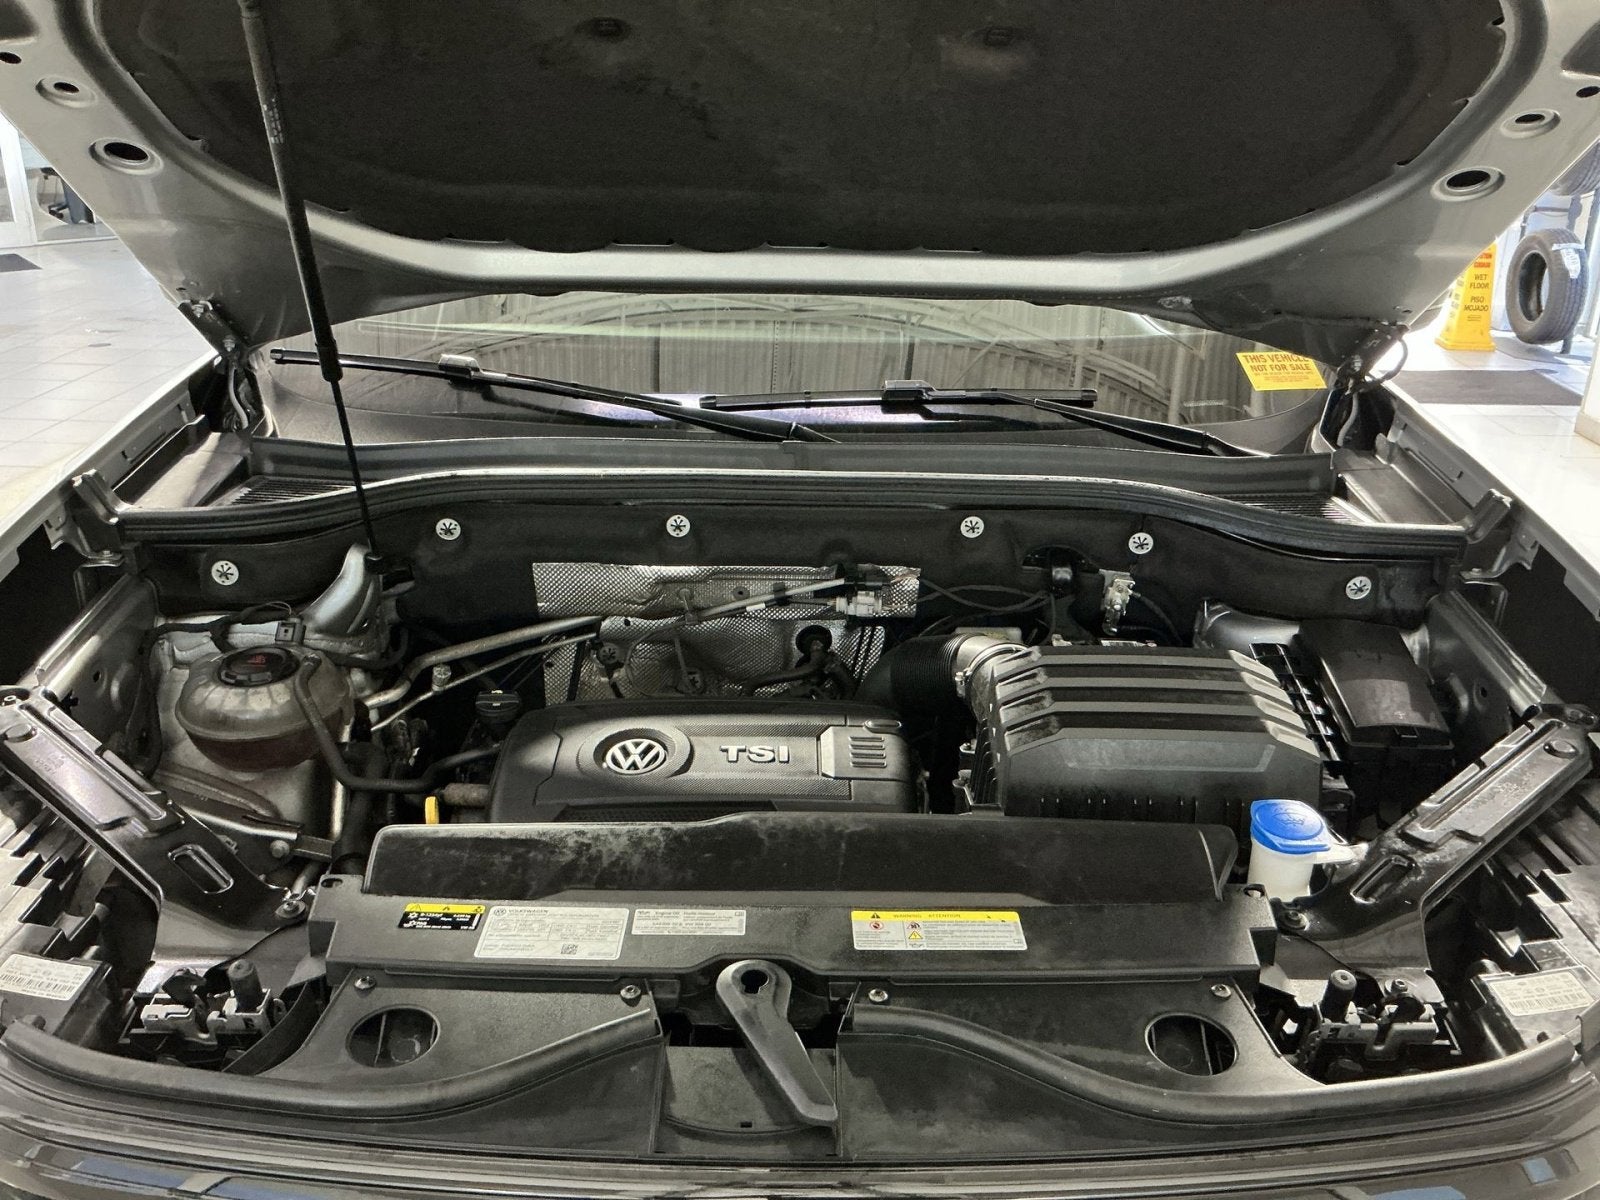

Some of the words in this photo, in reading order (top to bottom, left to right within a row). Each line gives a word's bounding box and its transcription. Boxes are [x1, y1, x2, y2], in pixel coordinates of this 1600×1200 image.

[1242, 355, 1267, 363] THIS
[1250, 364, 1268, 372] NOT
[1269, 364, 1288, 372] FOR
[1289, 363, 1311, 371] SALE
[720, 744, 790, 764] TSI
